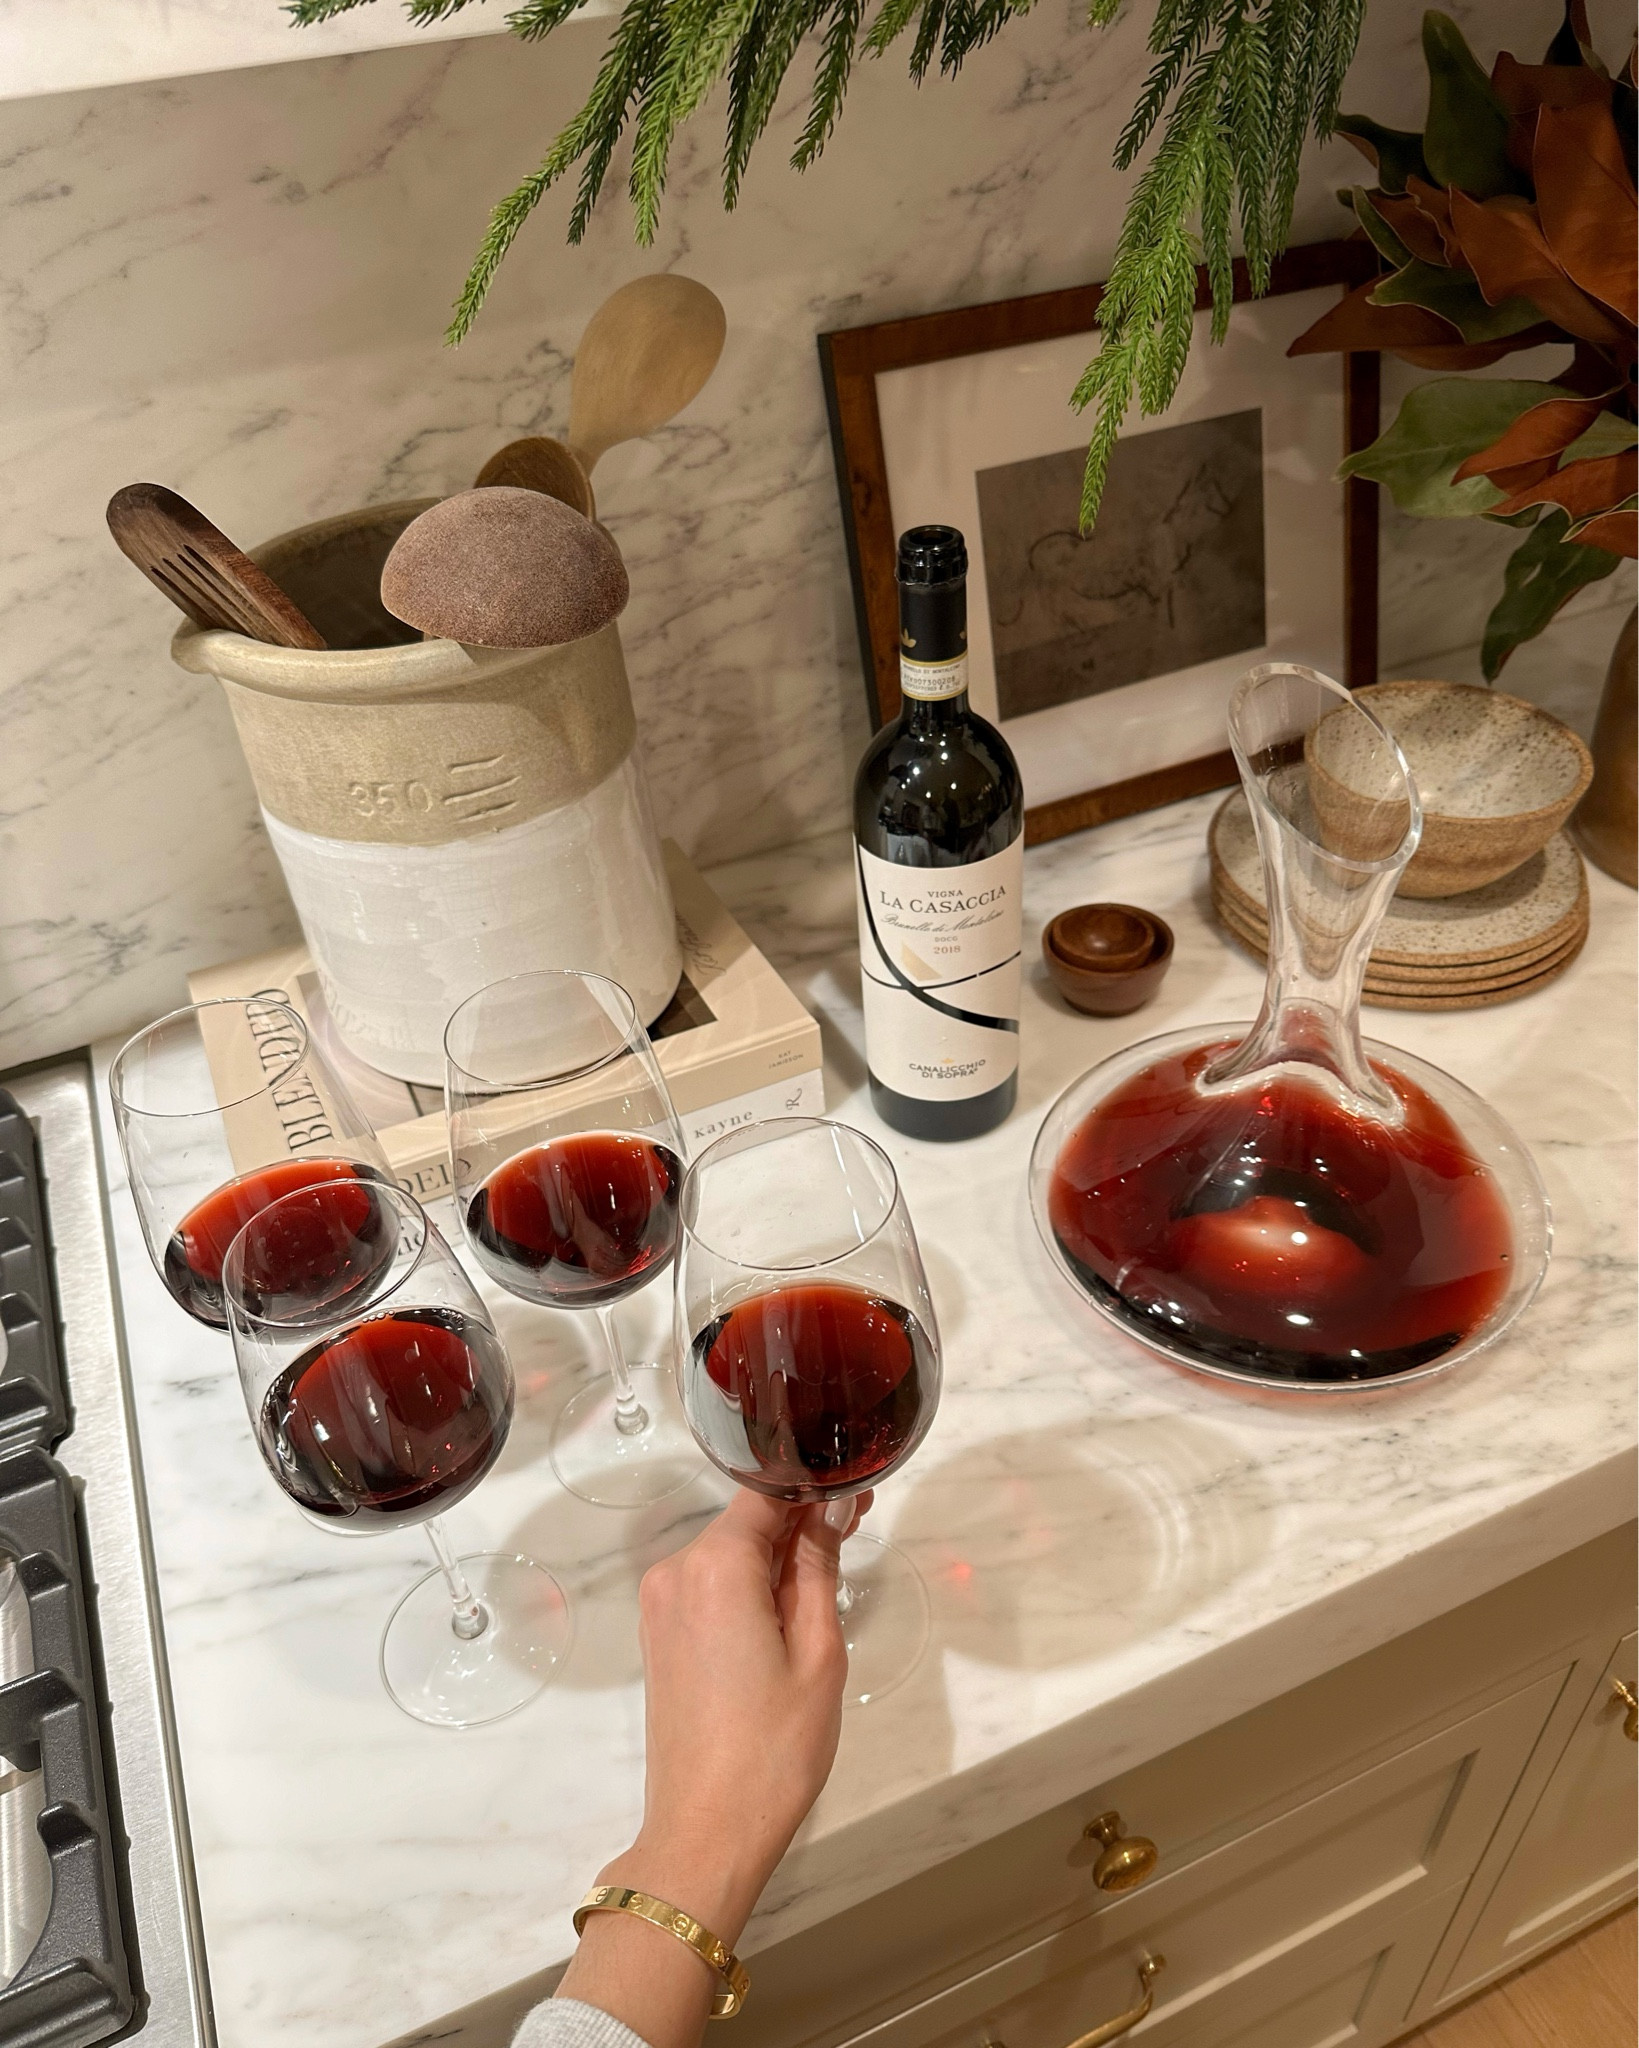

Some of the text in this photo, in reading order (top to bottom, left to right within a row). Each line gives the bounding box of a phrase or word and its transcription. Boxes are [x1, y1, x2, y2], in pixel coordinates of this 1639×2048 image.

[349, 778, 434, 822] 350
[880, 885, 1007, 914] LA CASACCIA
[927, 889, 964, 898] VIGNA
[934, 935, 958, 943] DOCG
[933, 945, 961, 955] 2018
[245, 988, 335, 1153] BLENDED
[908, 1059, 986, 1074] CANALICCHIO
[921, 1070, 933, 1079] DI
